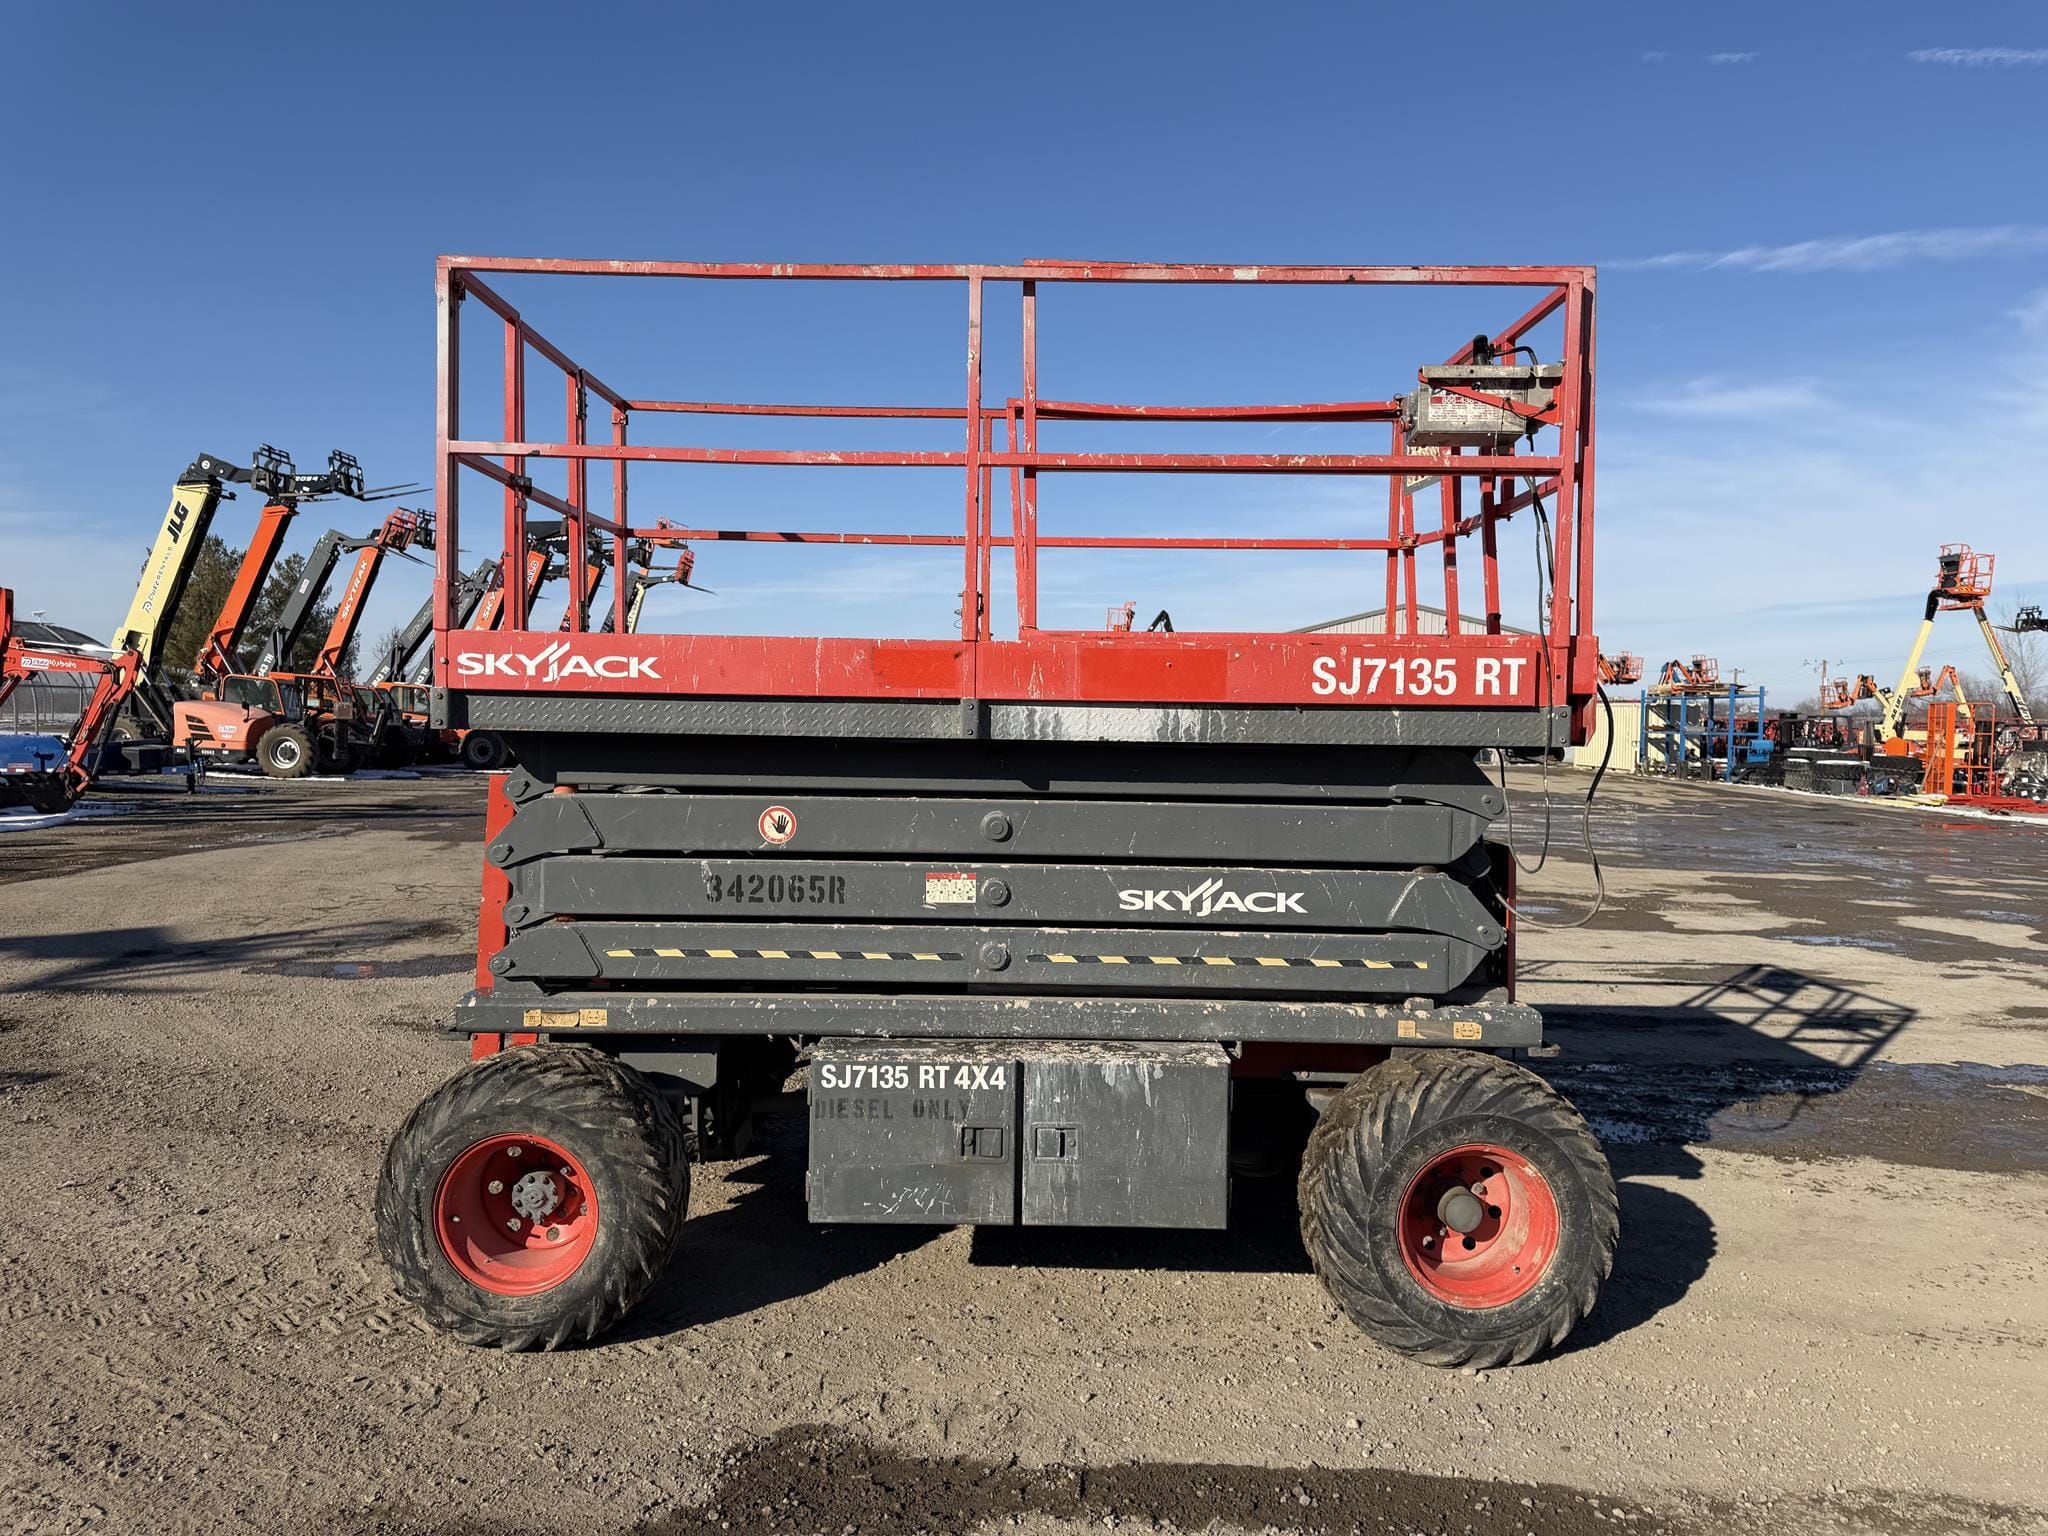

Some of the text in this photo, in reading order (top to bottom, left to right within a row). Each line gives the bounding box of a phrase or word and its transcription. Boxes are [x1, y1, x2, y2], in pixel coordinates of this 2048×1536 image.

[167, 500, 189, 545] JLG
[341, 560, 368, 619] SKYTRAK
[49, 659, 77, 669] Kubota
[456, 640, 662, 682] SKYJACK
[1311, 656, 1527, 696] SJ7135 RT
[706, 874, 845, 904] 342065R
[1119, 877, 1309, 917] SKYJACK
[821, 1064, 1006, 1090] SJ7135 RT 4X4
[814, 1098, 974, 1120] DIESEL ONLY
